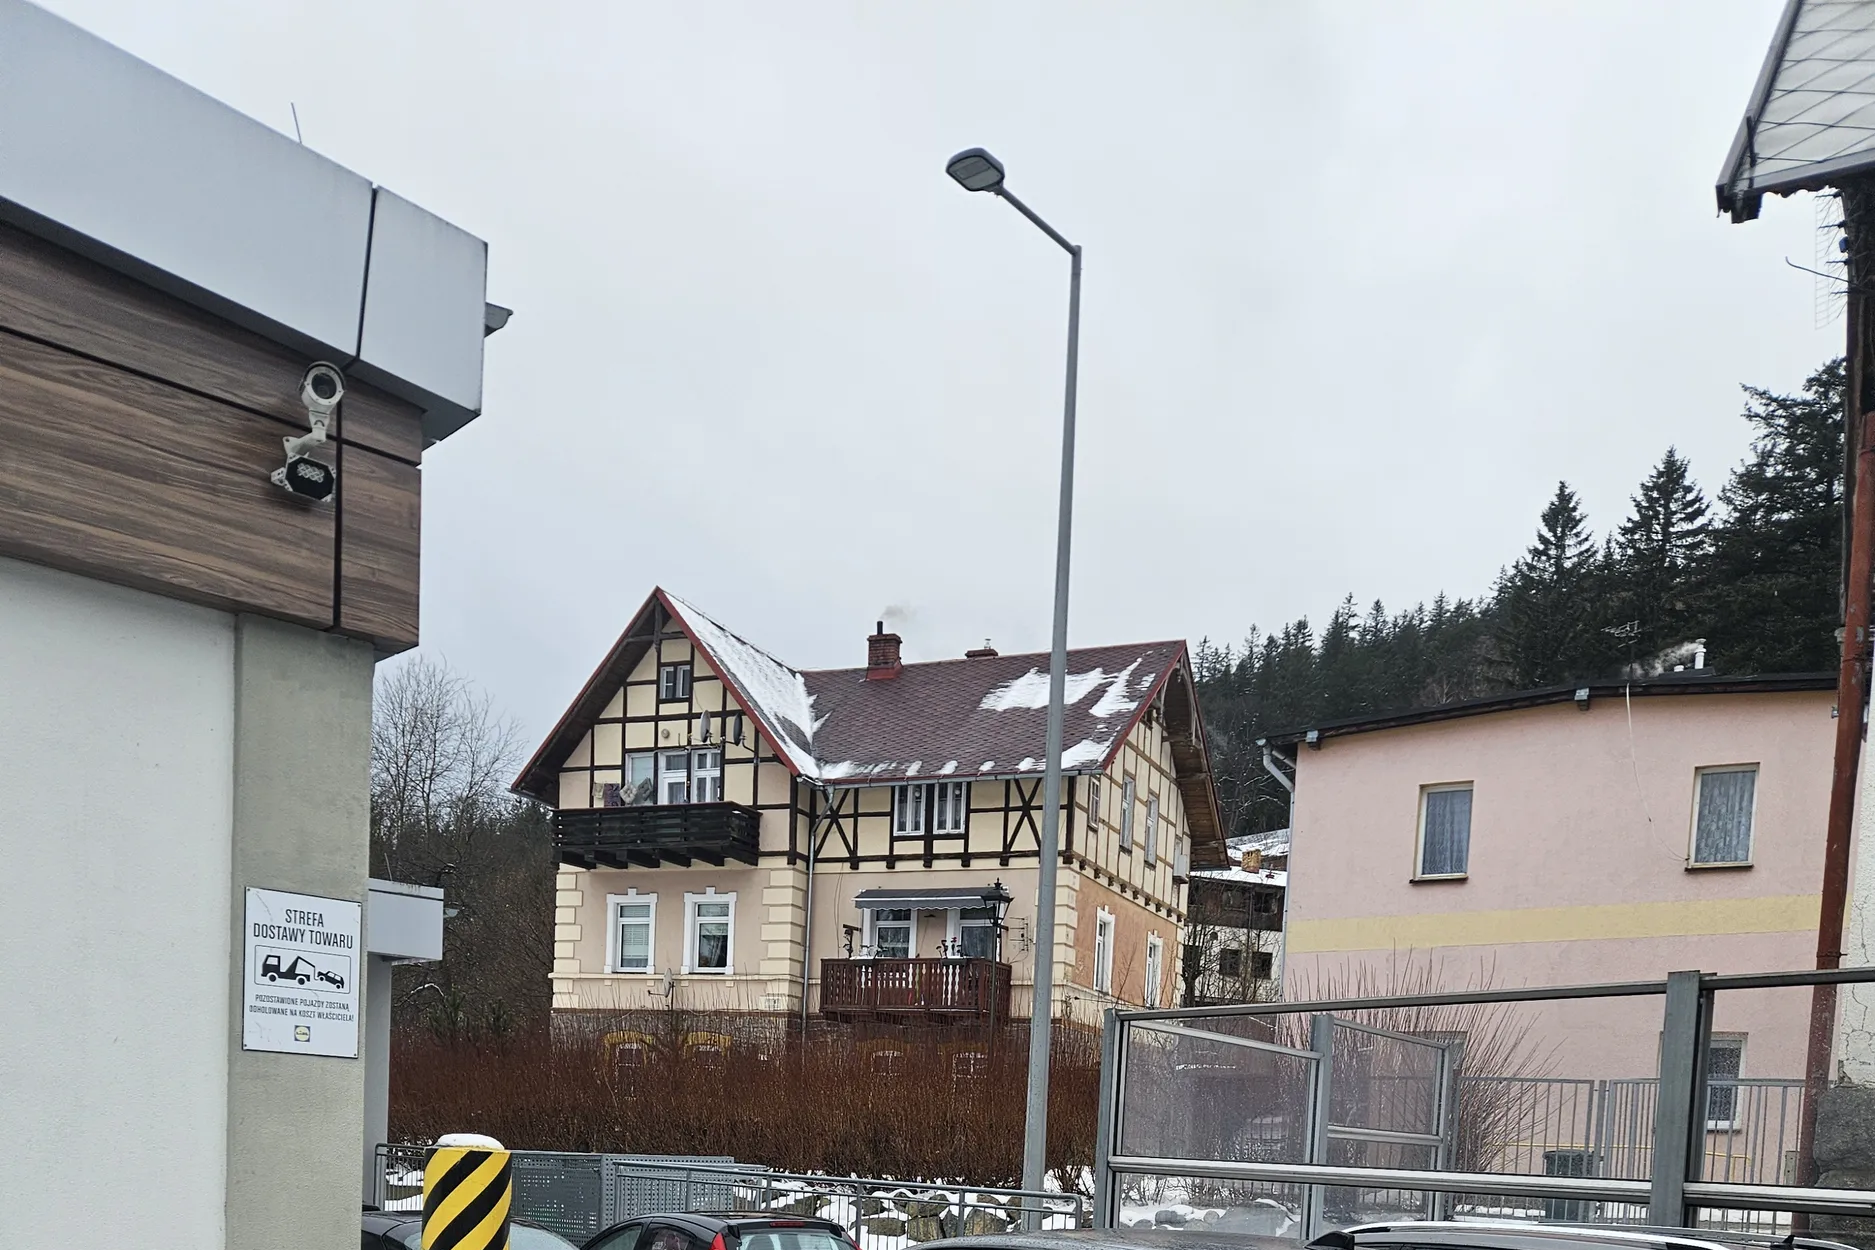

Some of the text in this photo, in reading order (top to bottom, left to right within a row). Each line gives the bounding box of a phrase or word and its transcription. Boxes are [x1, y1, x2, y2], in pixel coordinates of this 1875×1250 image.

[285, 908, 324, 927] STREFA
[253, 923, 353, 949] DOSTAWY TOWARU
[255, 994, 298, 1006] POZOSTAWIONE
[299, 998, 324, 1008] POJAZDY
[249, 1005, 288, 1016] ODHOLOWANE
[289, 1008, 297, 1016] NA
[299, 1009, 316, 1018] KOSZT
